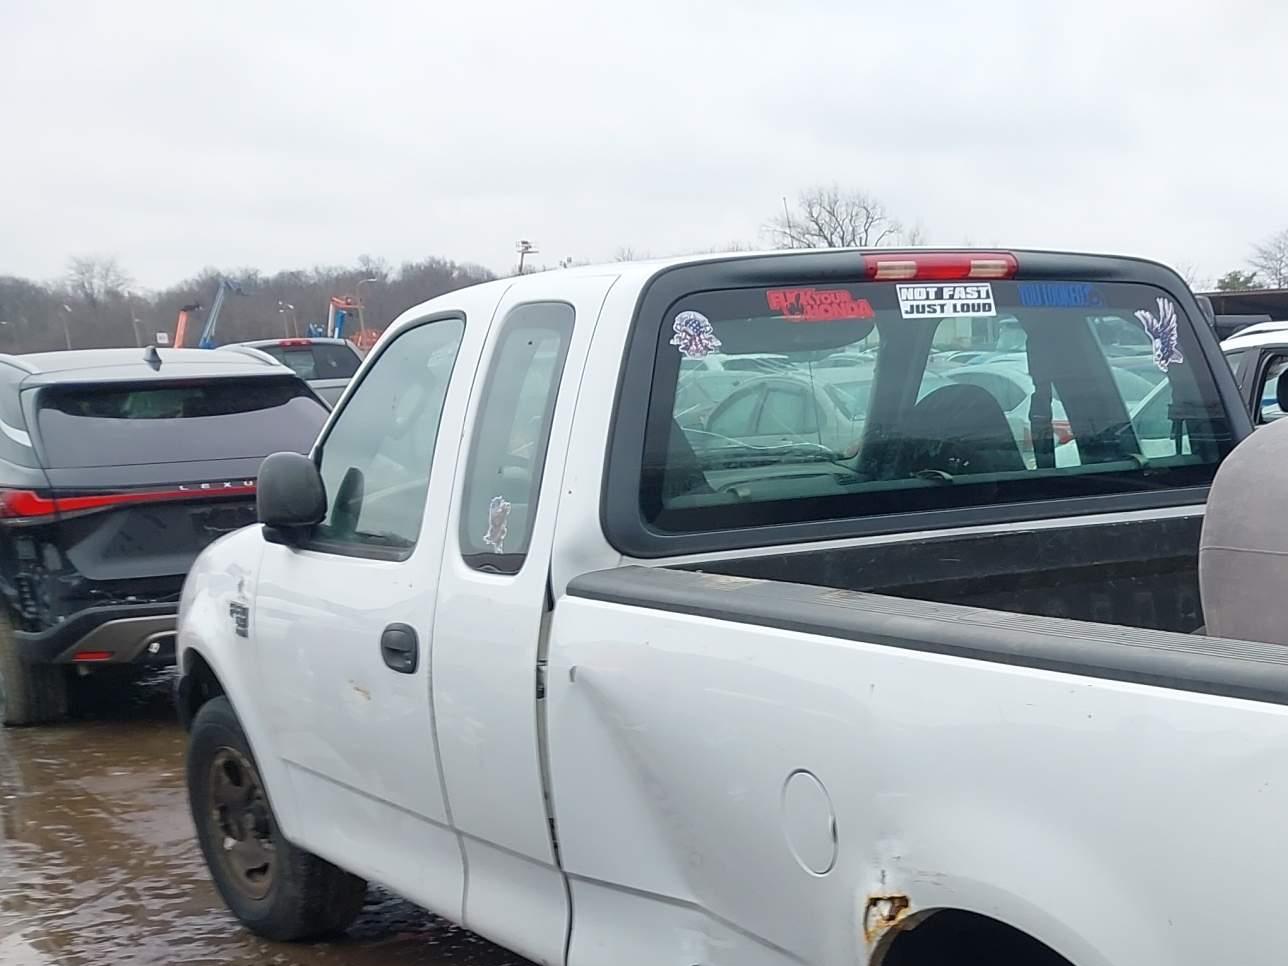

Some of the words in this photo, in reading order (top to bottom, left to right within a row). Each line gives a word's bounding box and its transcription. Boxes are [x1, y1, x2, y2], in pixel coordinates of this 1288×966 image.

[900, 287, 937, 300] NOT
[943, 286, 991, 299] FAST
[904, 303, 947, 314] JUST
[952, 302, 992, 313] LOUD
[179, 480, 254, 491] LEXU
